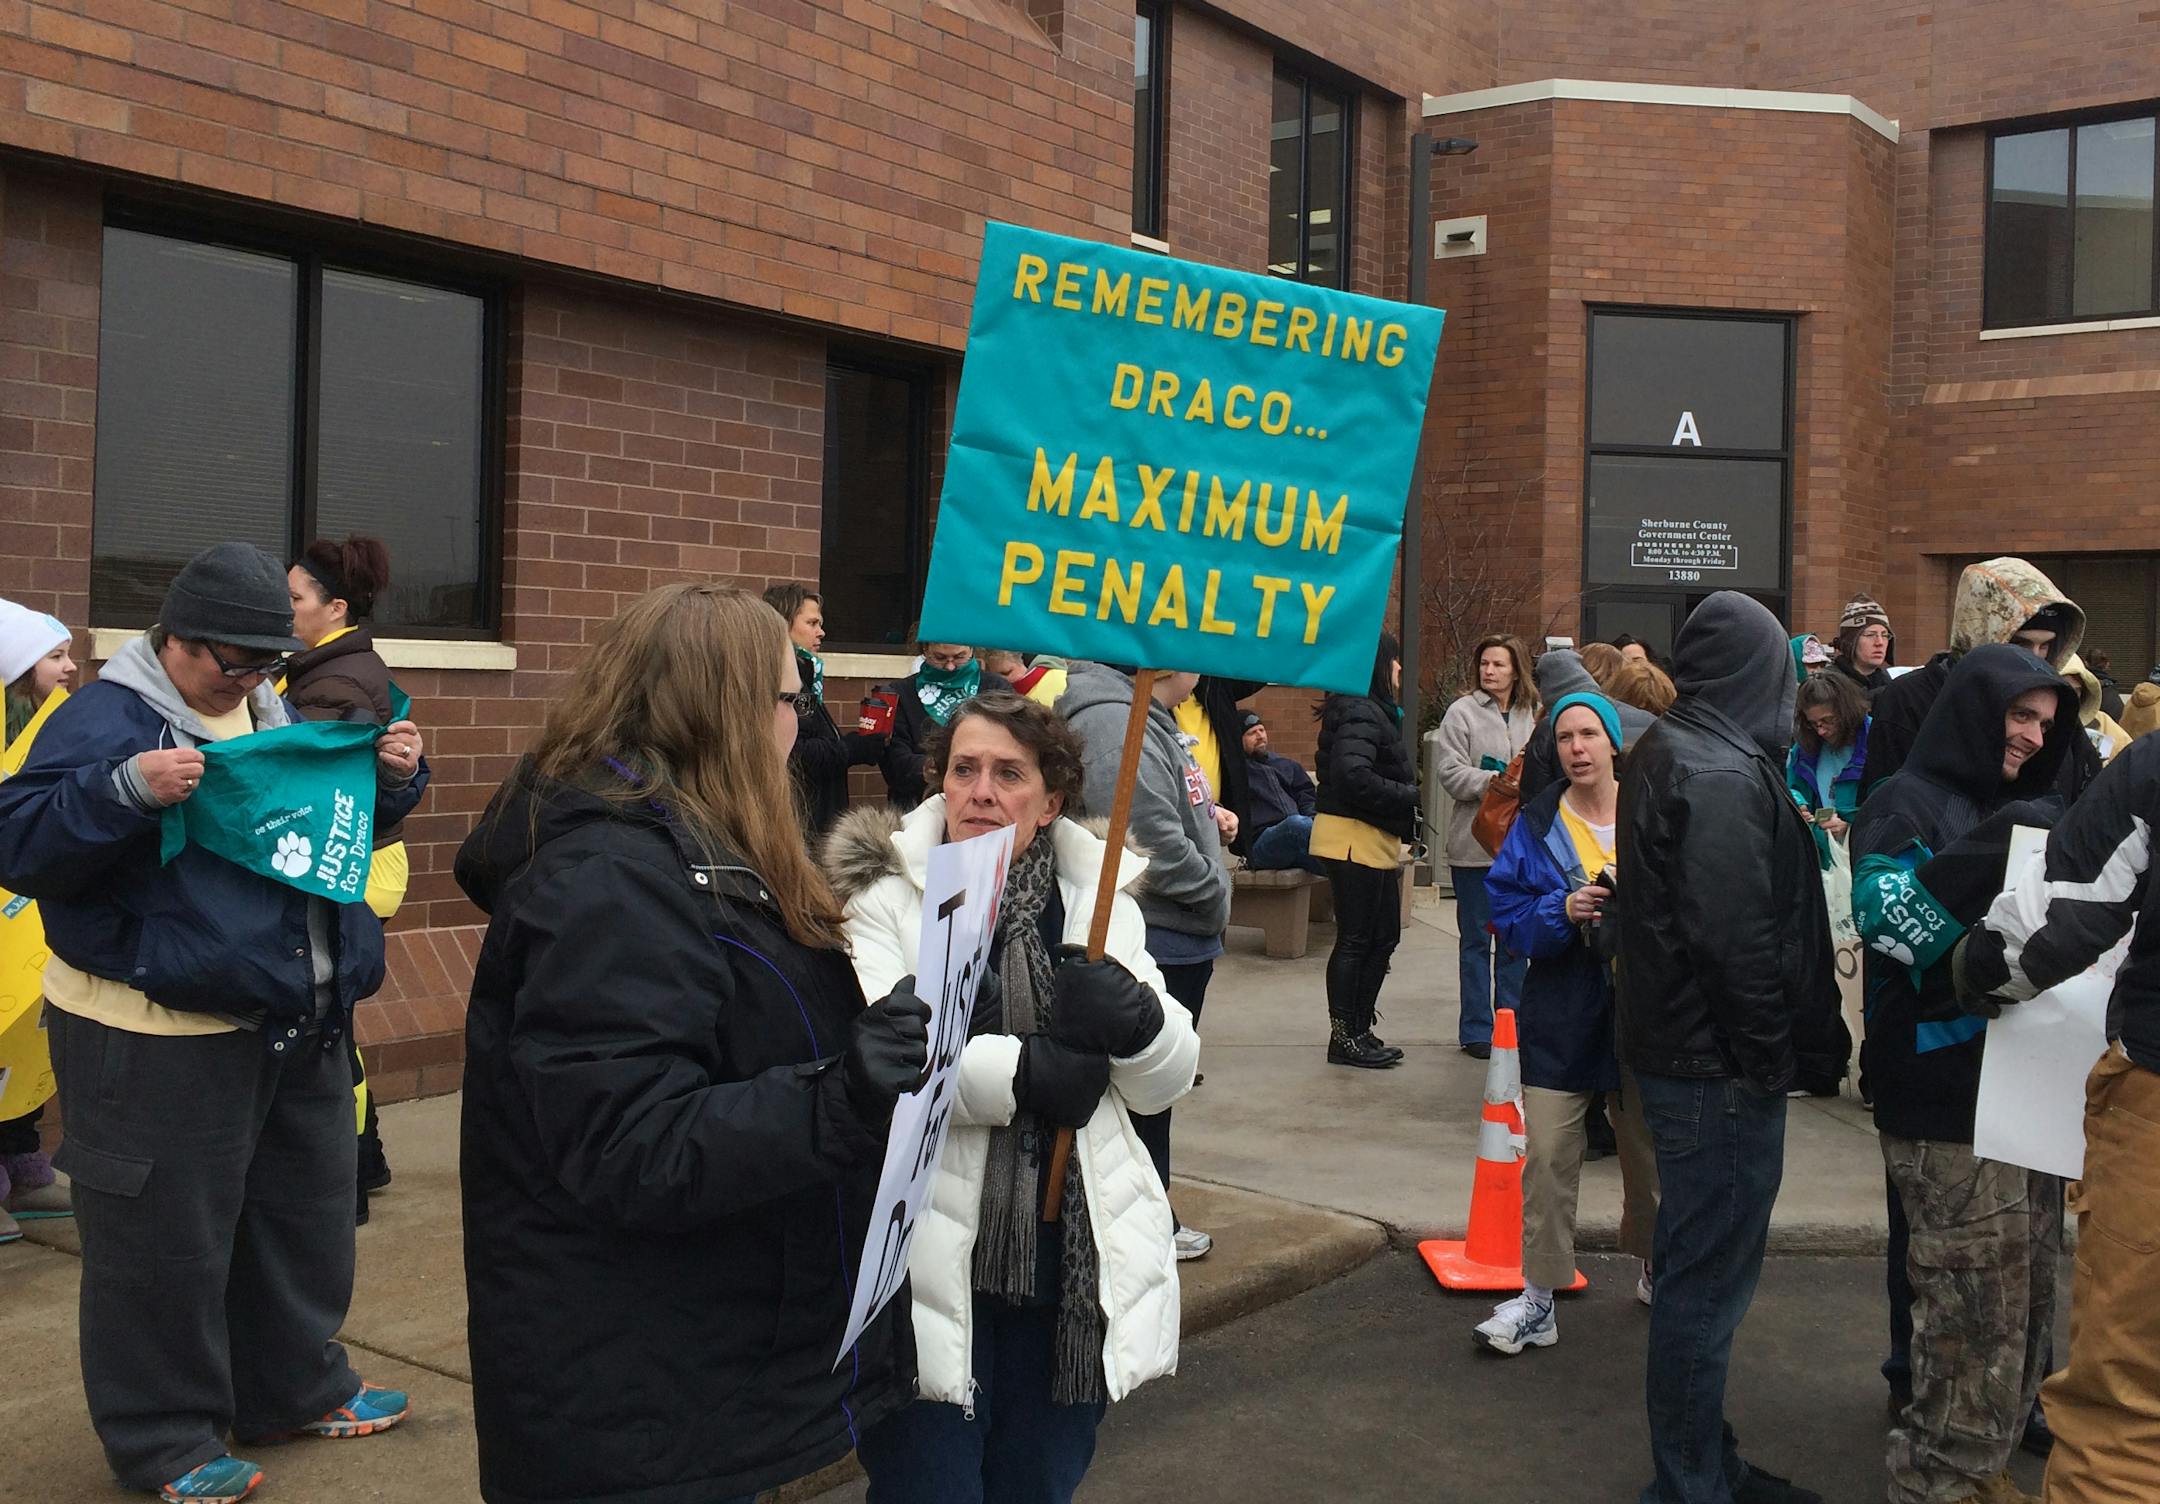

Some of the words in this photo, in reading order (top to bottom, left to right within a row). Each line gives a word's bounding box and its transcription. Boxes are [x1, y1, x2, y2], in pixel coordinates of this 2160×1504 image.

[1012, 253, 1409, 368] REMEMBERING
[1109, 361, 1328, 440] DRACO...
[1671, 411, 1702, 447] A
[1025, 446, 1349, 555] MAXIMUM
[1638, 529, 1697, 540] Government
[1699, 531, 1732, 541] Center
[1641, 518, 1691, 529] Sherburne
[1693, 520, 1728, 531] County
[1643, 556, 1671, 564] Monday
[1673, 557, 1701, 565] through
[1702, 557, 1726, 566] Friday
[1668, 570, 1700, 581] 13880
[997, 541, 1336, 645] PENALTY
[266, 813, 291, 830] their
[291, 804, 313, 819] voice
[316, 788, 355, 890] JUSTICE
[350, 810, 369, 859] Draco
[339, 861, 362, 894] for
[1915, 902, 1946, 931] for
